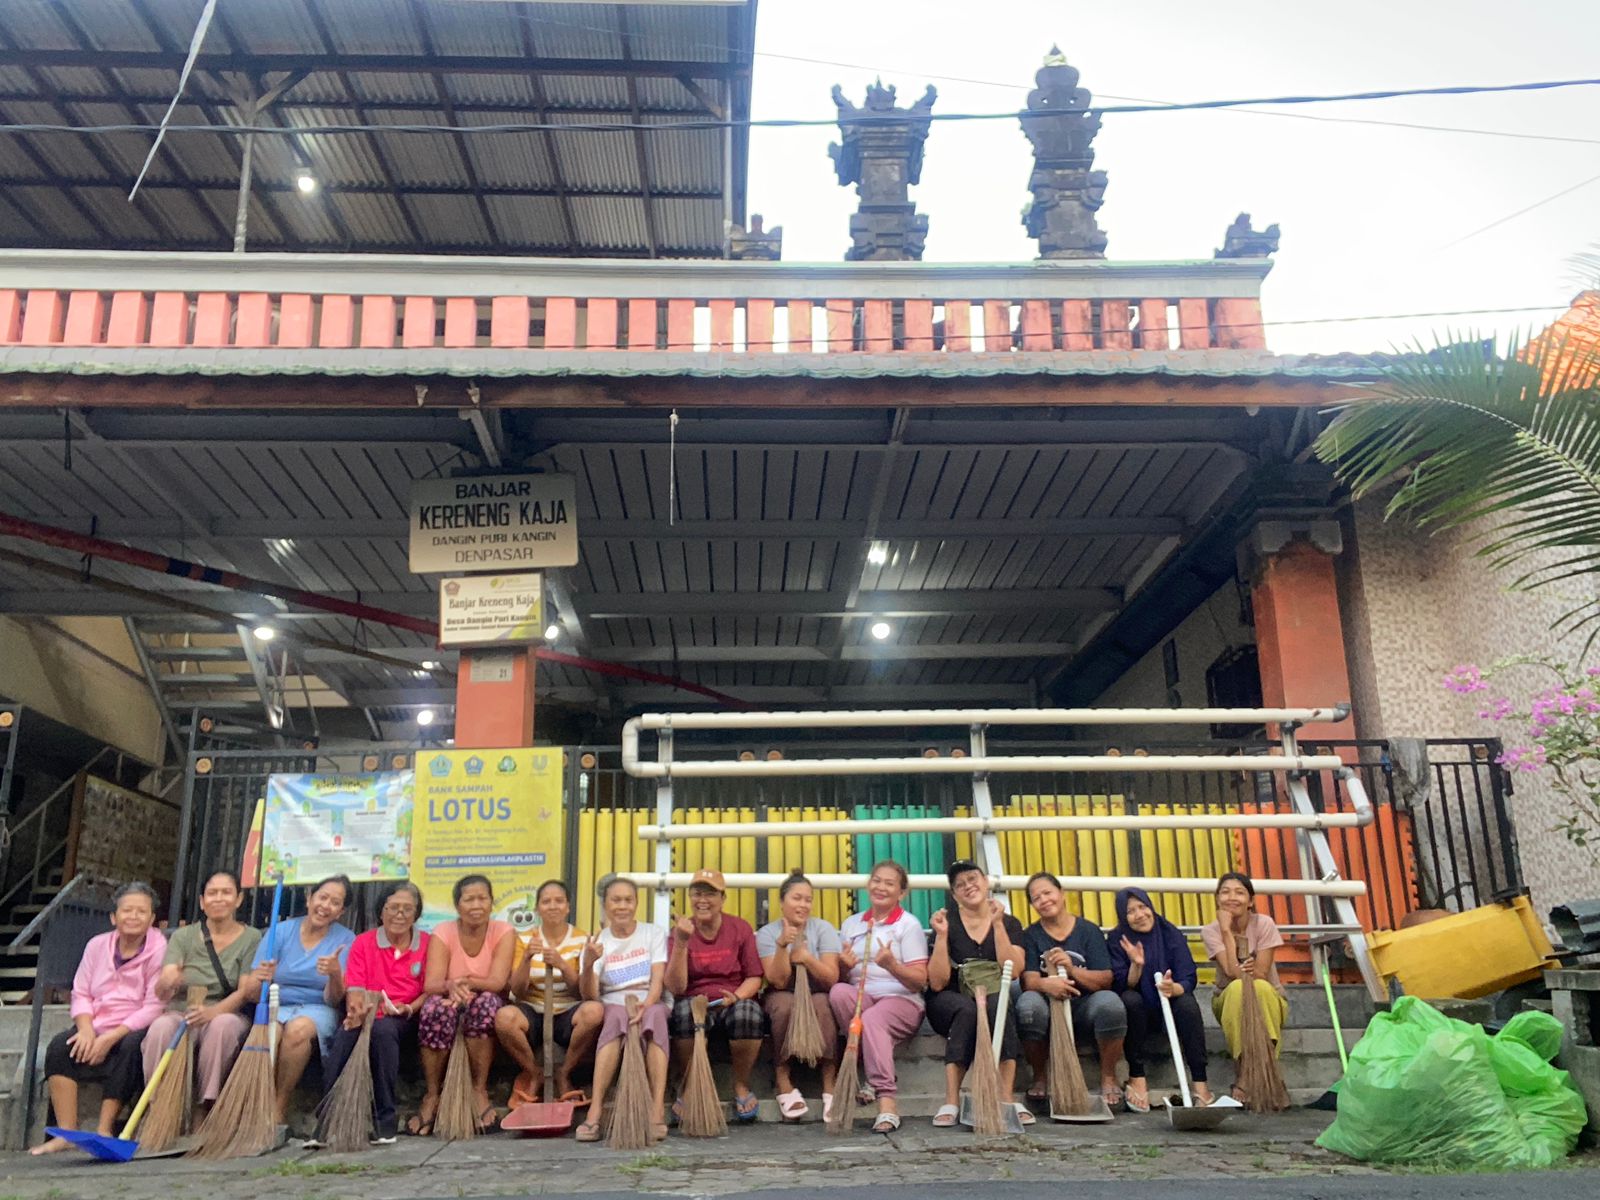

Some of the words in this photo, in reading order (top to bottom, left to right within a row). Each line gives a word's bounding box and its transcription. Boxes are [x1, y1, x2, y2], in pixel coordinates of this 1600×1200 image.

[455, 481, 532, 499] BANJAR
[419, 502, 510, 530] KERENENG
[519, 499, 568, 526] KAJA
[432, 535, 476, 546] DANGIN
[480, 533, 508, 544] PURI
[512, 531, 557, 543] KANGIN
[455, 547, 534, 563] DENPASAR
[429, 797, 512, 822] LOTUS
